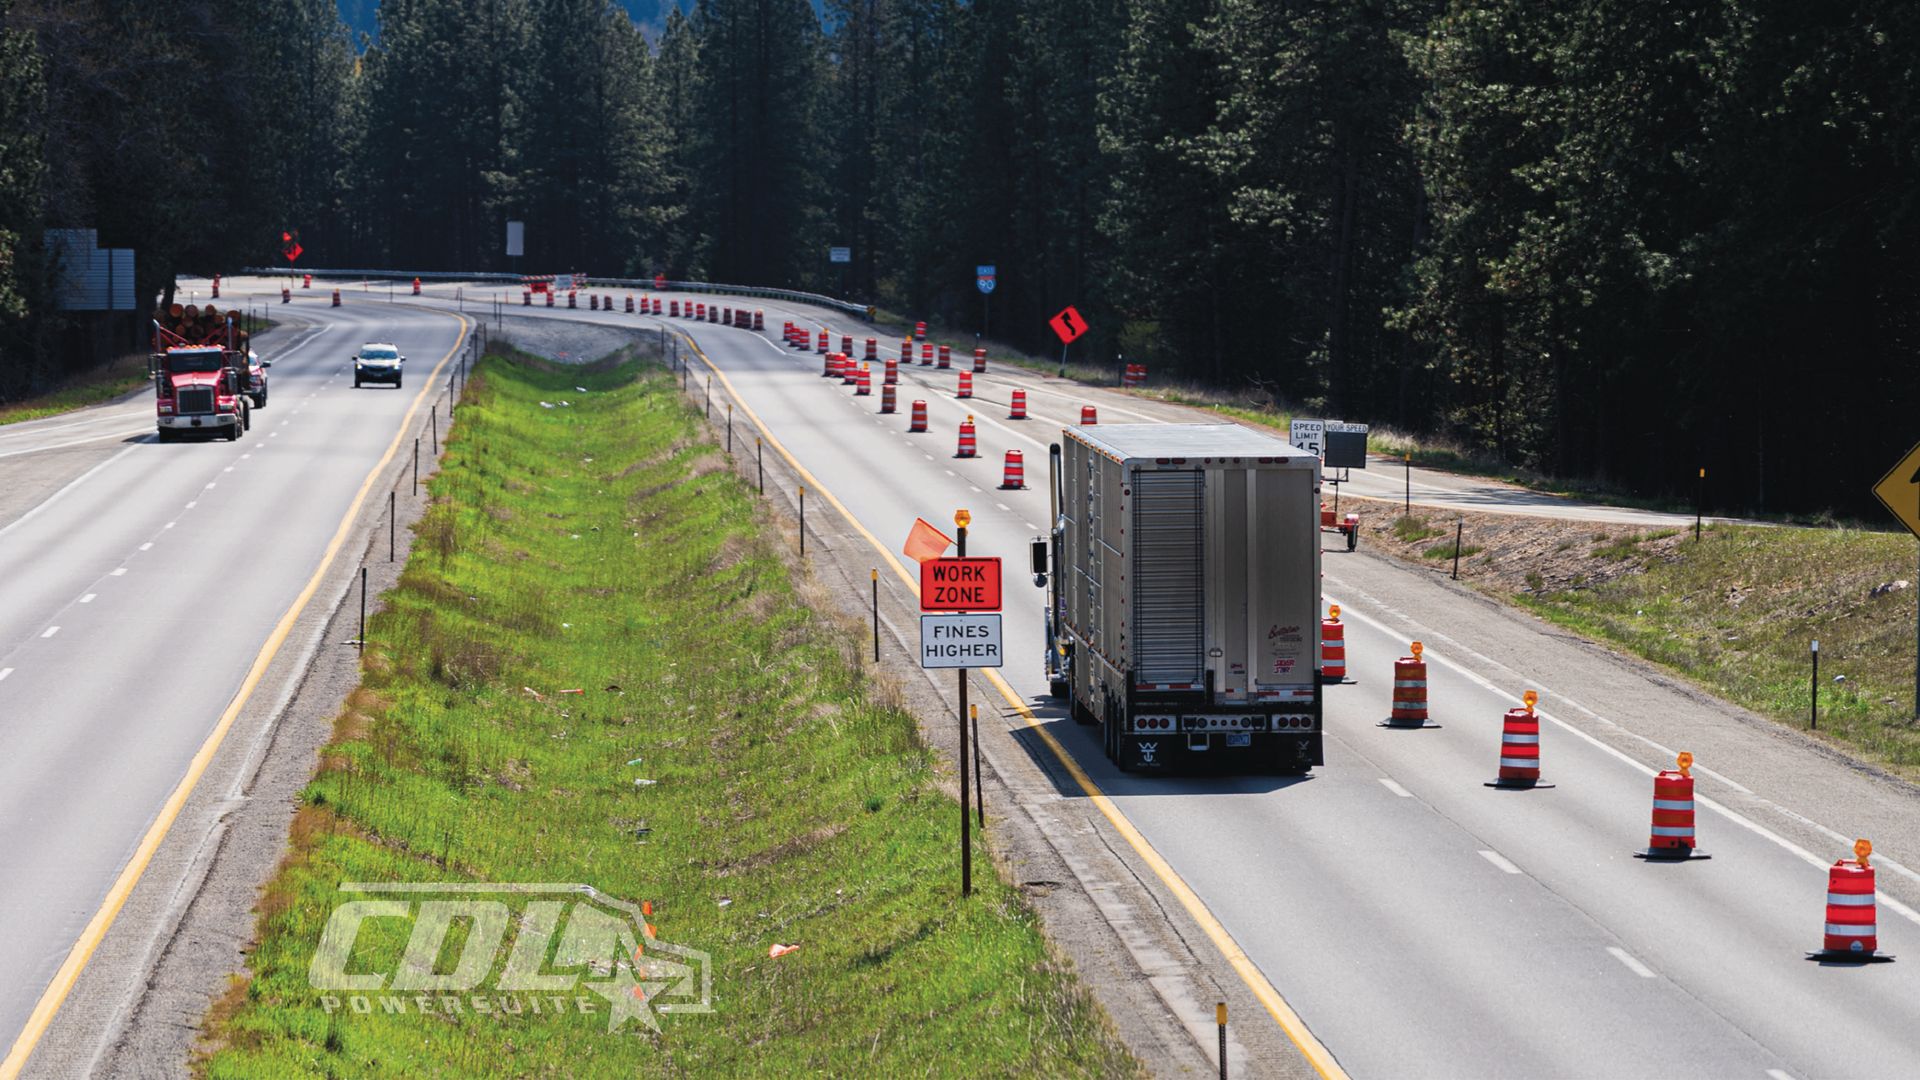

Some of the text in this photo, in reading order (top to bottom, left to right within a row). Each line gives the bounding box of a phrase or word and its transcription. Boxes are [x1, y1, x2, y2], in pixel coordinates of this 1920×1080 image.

[978, 279, 994, 290] 90
[1293, 423, 1321, 431] SPEED
[1327, 424, 1367, 432] YOUR SPEED
[933, 565, 986, 581] WORK
[934, 586, 985, 603] ZONE
[934, 625, 990, 638] FINES
[926, 643, 998, 657] HIGHER
